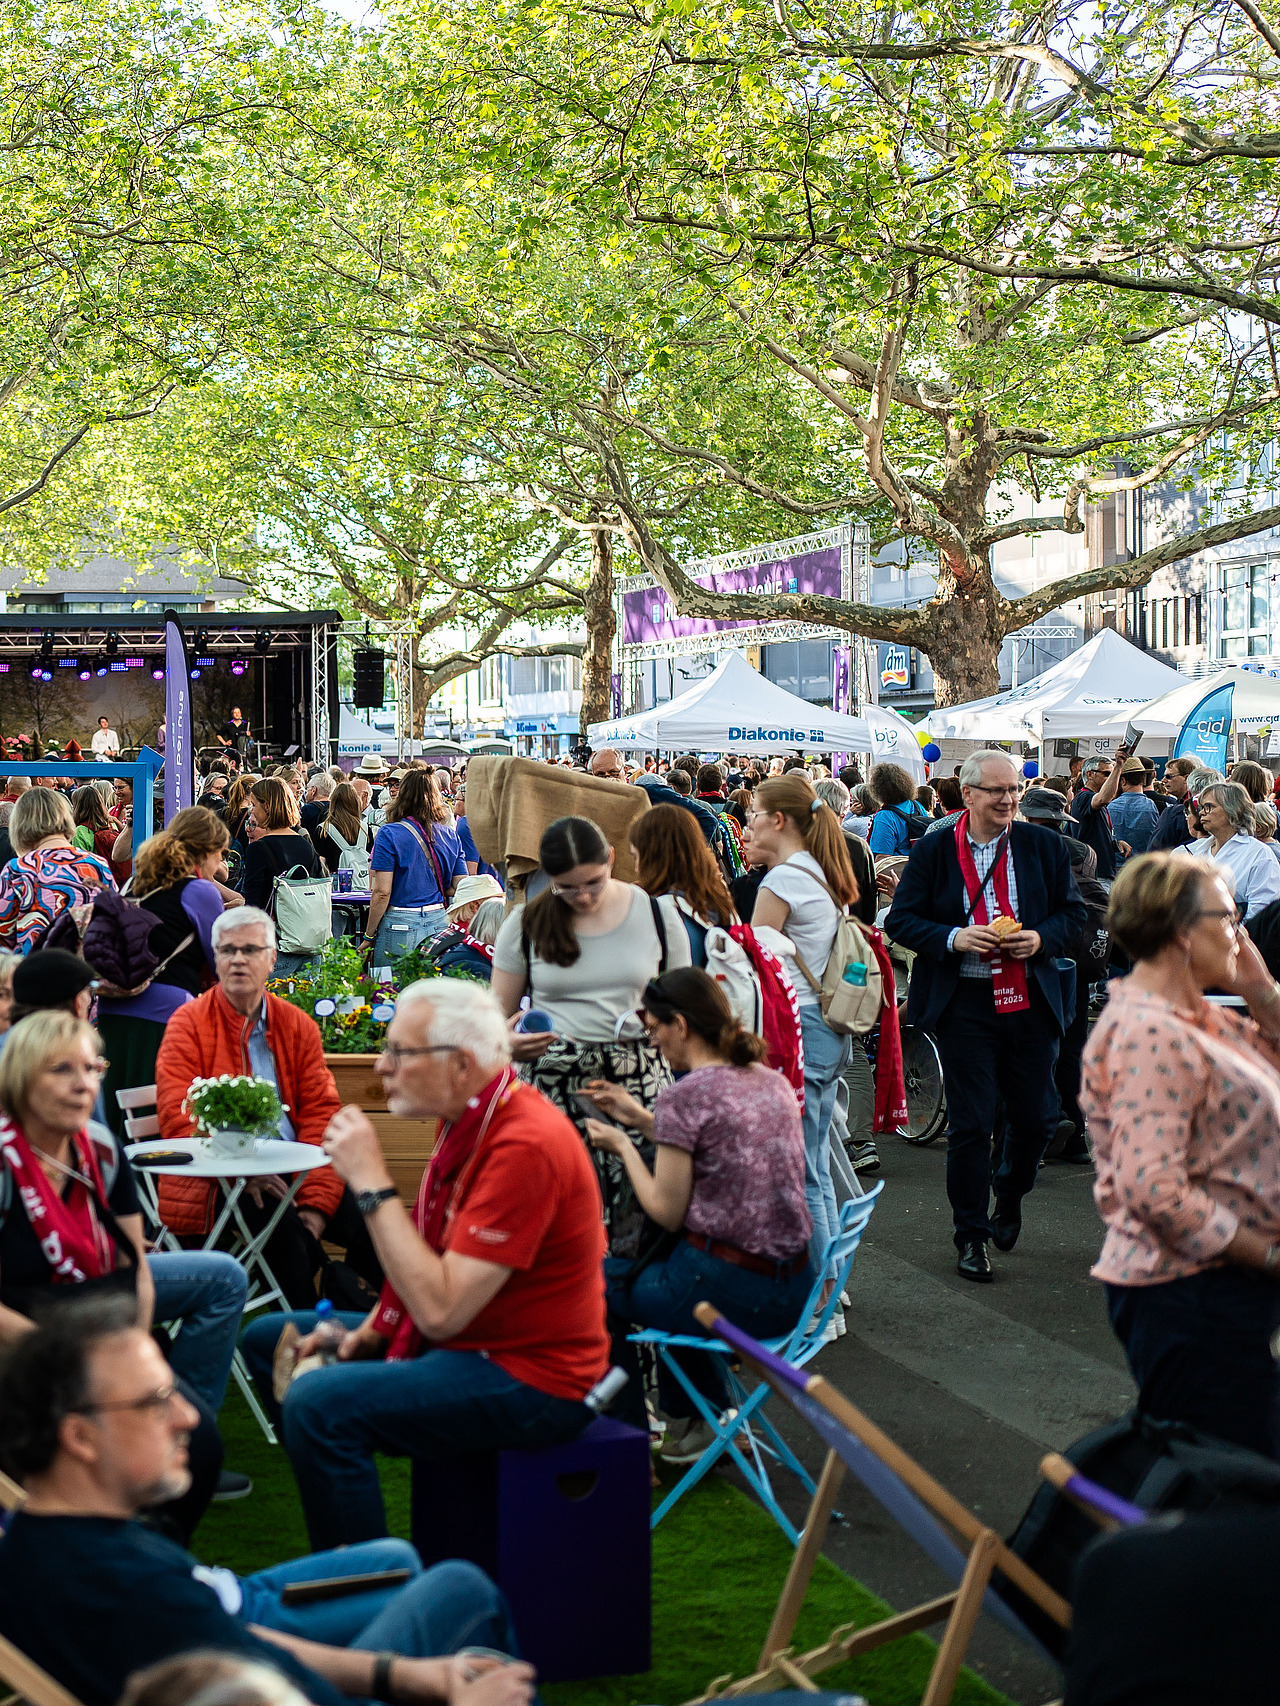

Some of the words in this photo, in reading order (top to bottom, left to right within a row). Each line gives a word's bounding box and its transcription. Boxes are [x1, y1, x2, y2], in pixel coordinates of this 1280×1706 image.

[886, 648, 904, 671] dm
[728, 726, 806, 742] Diakonie
[1197, 716, 1225, 738] cjd
[1094, 737, 1110, 751] cjd
[993, 987, 1014, 996] entag
[1003, 994, 1024, 1005] 2025
